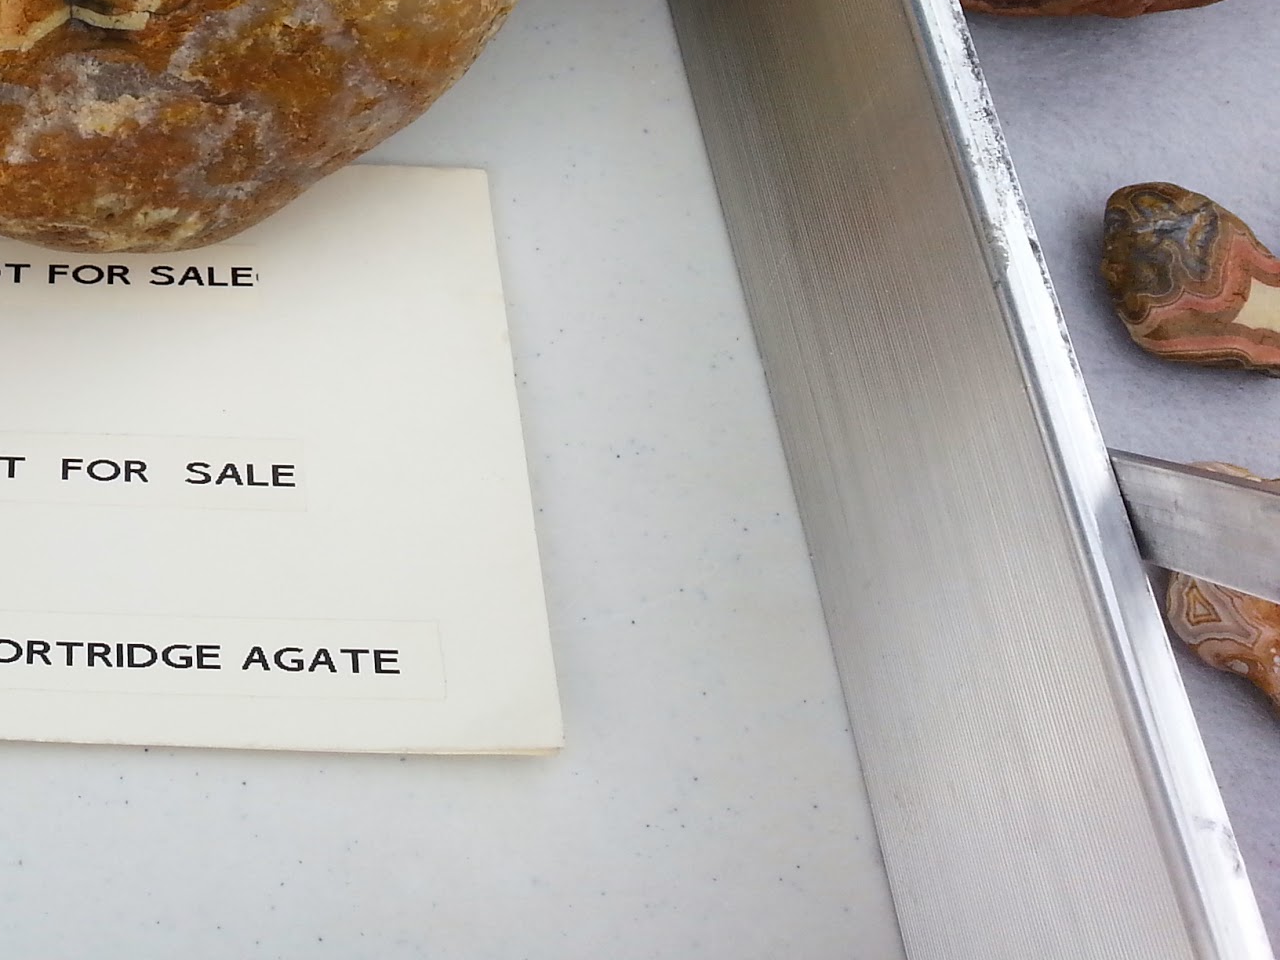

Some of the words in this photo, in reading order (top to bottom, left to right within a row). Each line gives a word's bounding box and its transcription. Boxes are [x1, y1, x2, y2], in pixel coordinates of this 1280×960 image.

[48, 264, 131, 286] FOR
[149, 265, 254, 287] SALE
[61, 458, 149, 483] FOR
[184, 462, 296, 487] SALE
[242, 646, 401, 675] AGATE
